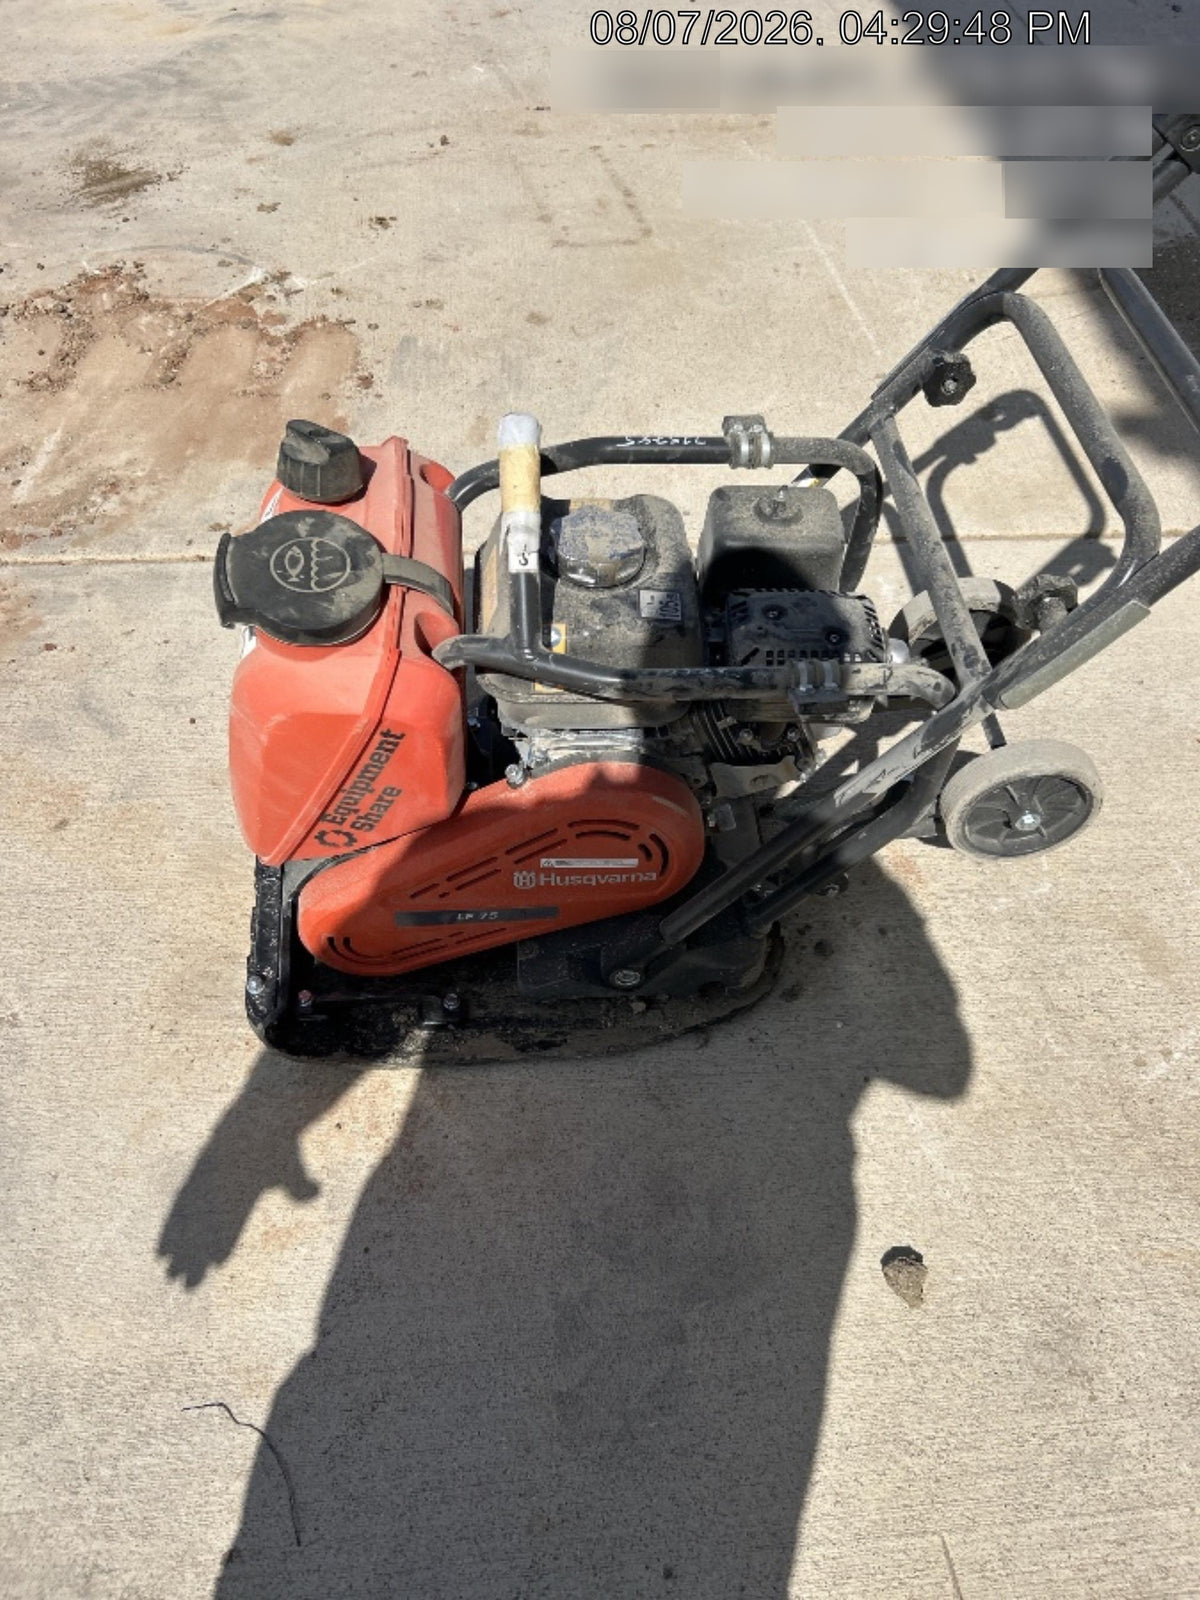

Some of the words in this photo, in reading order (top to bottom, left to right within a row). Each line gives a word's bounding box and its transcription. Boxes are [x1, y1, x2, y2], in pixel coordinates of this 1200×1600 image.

[320, 728, 406, 826] Equipment
[350, 785, 402, 832] Share
[539, 871, 657, 887] Husqvarna
